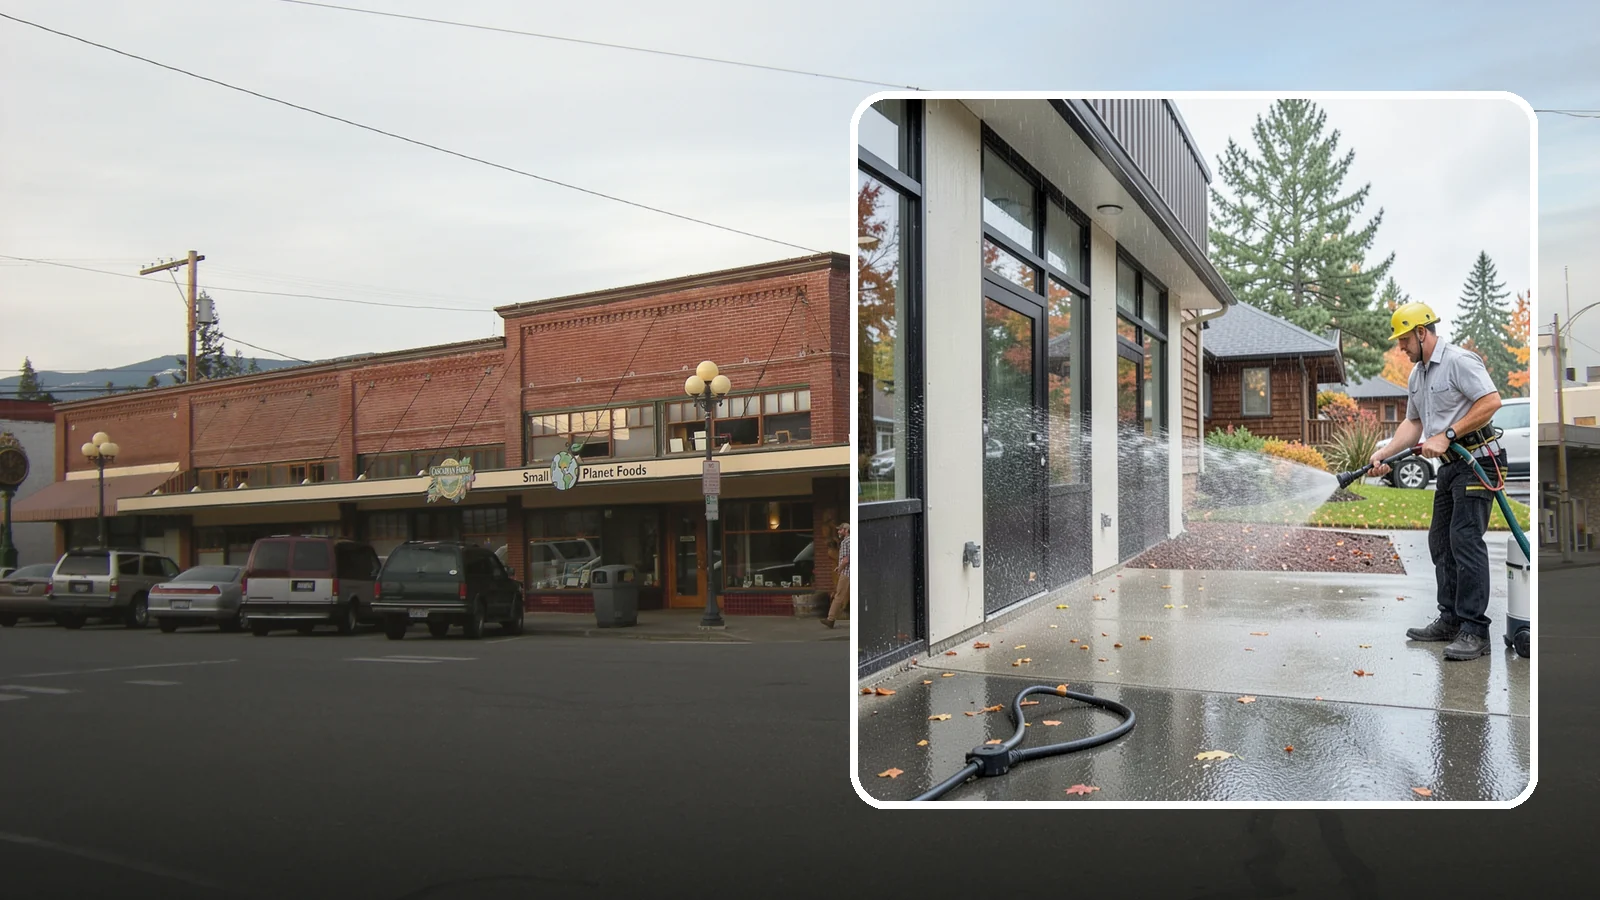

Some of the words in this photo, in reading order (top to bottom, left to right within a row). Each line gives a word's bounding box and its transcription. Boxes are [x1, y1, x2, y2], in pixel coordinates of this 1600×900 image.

[431, 467, 456, 476] CASCADIAN
[456, 466, 469, 475] FARM
[523, 470, 549, 483] Small
[583, 468, 614, 479] Planet
[616, 464, 647, 477] Foods
